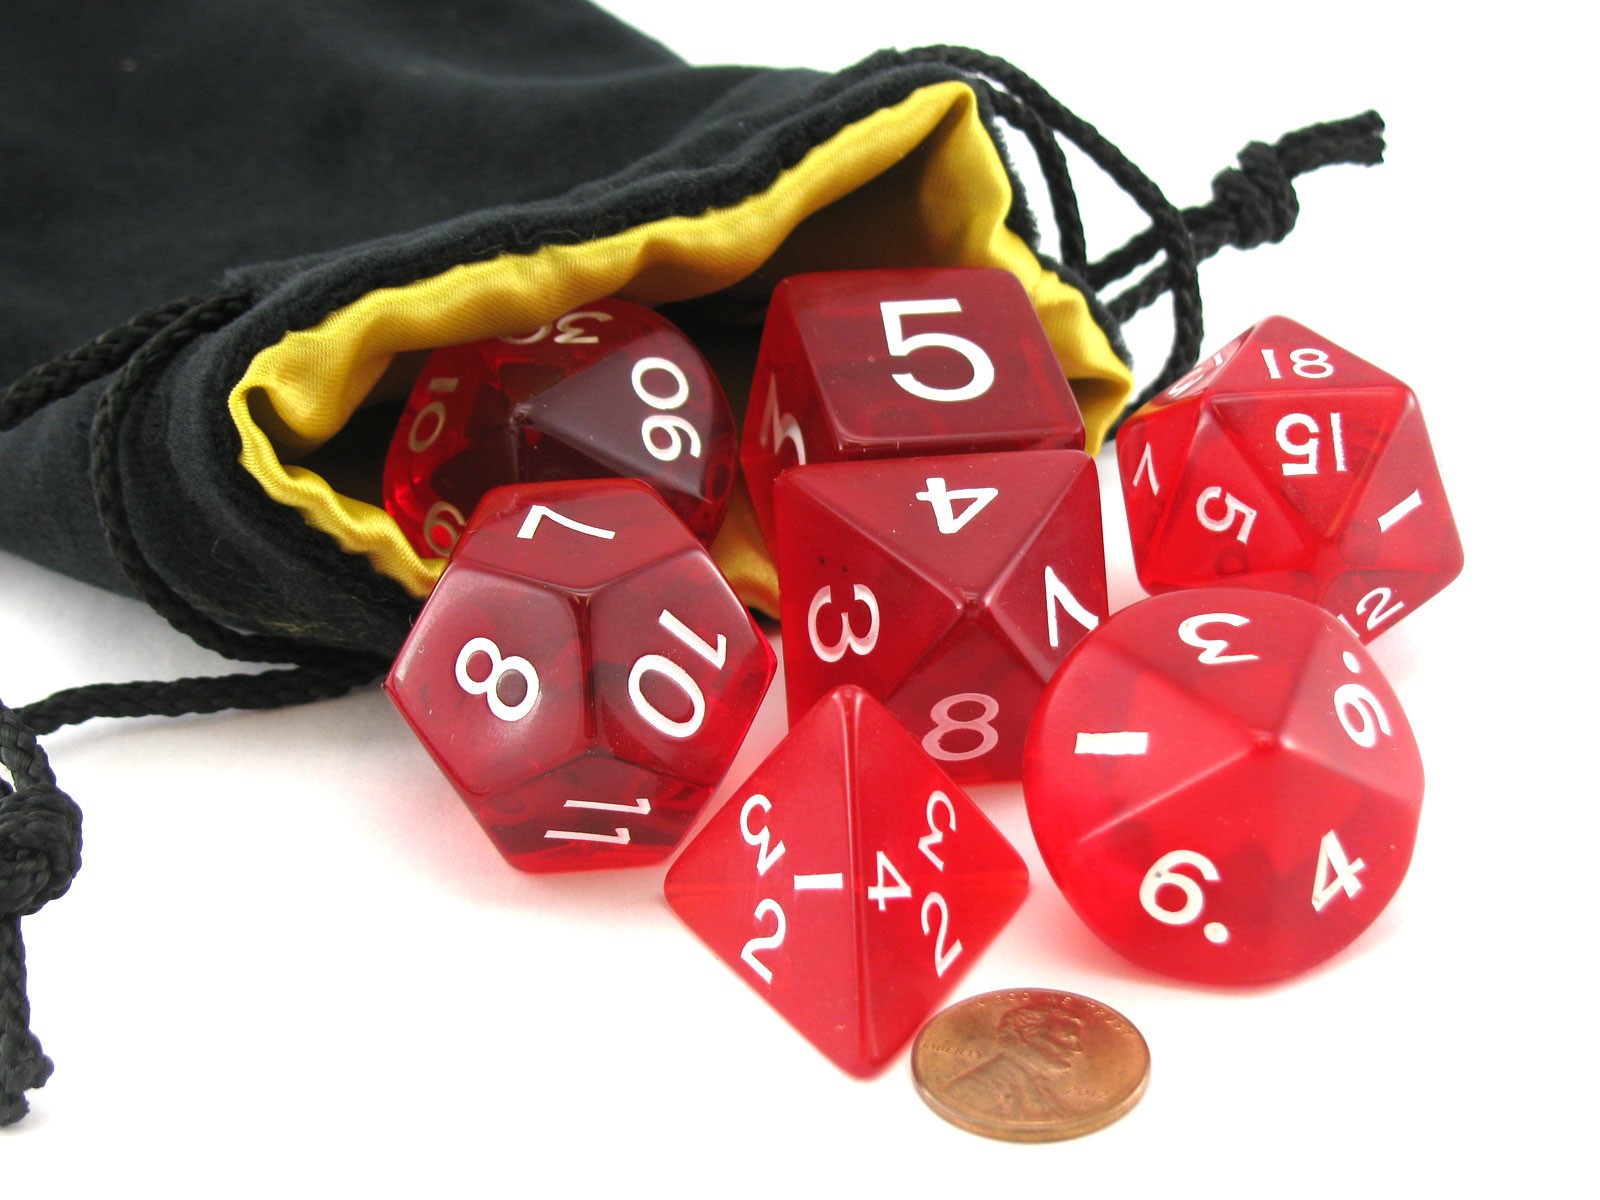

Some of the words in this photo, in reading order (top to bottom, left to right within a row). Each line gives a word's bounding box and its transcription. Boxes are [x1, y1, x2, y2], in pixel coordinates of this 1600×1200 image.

[880, 298, 995, 402] 5
[1261, 348, 1334, 379] 18
[409, 377, 459, 453] 10
[631, 357, 701, 461] 90
[1133, 442, 1160, 496] 7
[1275, 412, 1347, 476] 15
[517, 504, 616, 539] 7
[915, 477, 999, 534] 4
[1195, 486, 1257, 544] 5
[1377, 489, 1423, 533] 1
[807, 583, 880, 663] 3
[1044, 566, 1099, 647] 7
[1178, 612, 1259, 664] 3
[455, 637, 540, 722] 8
[627, 608, 727, 738] 10
[922, 692, 999, 761] 8
[1074, 731, 1148, 755] 1
[544, 798, 651, 845] 11
[740, 794, 786, 877] 3
[918, 790, 956, 871] 3
[793, 872, 843, 890] 1
[867, 850, 912, 911] 4
[1312, 829, 1366, 912] 4
[740, 898, 786, 984] 2
[920, 891, 963, 979] 2
